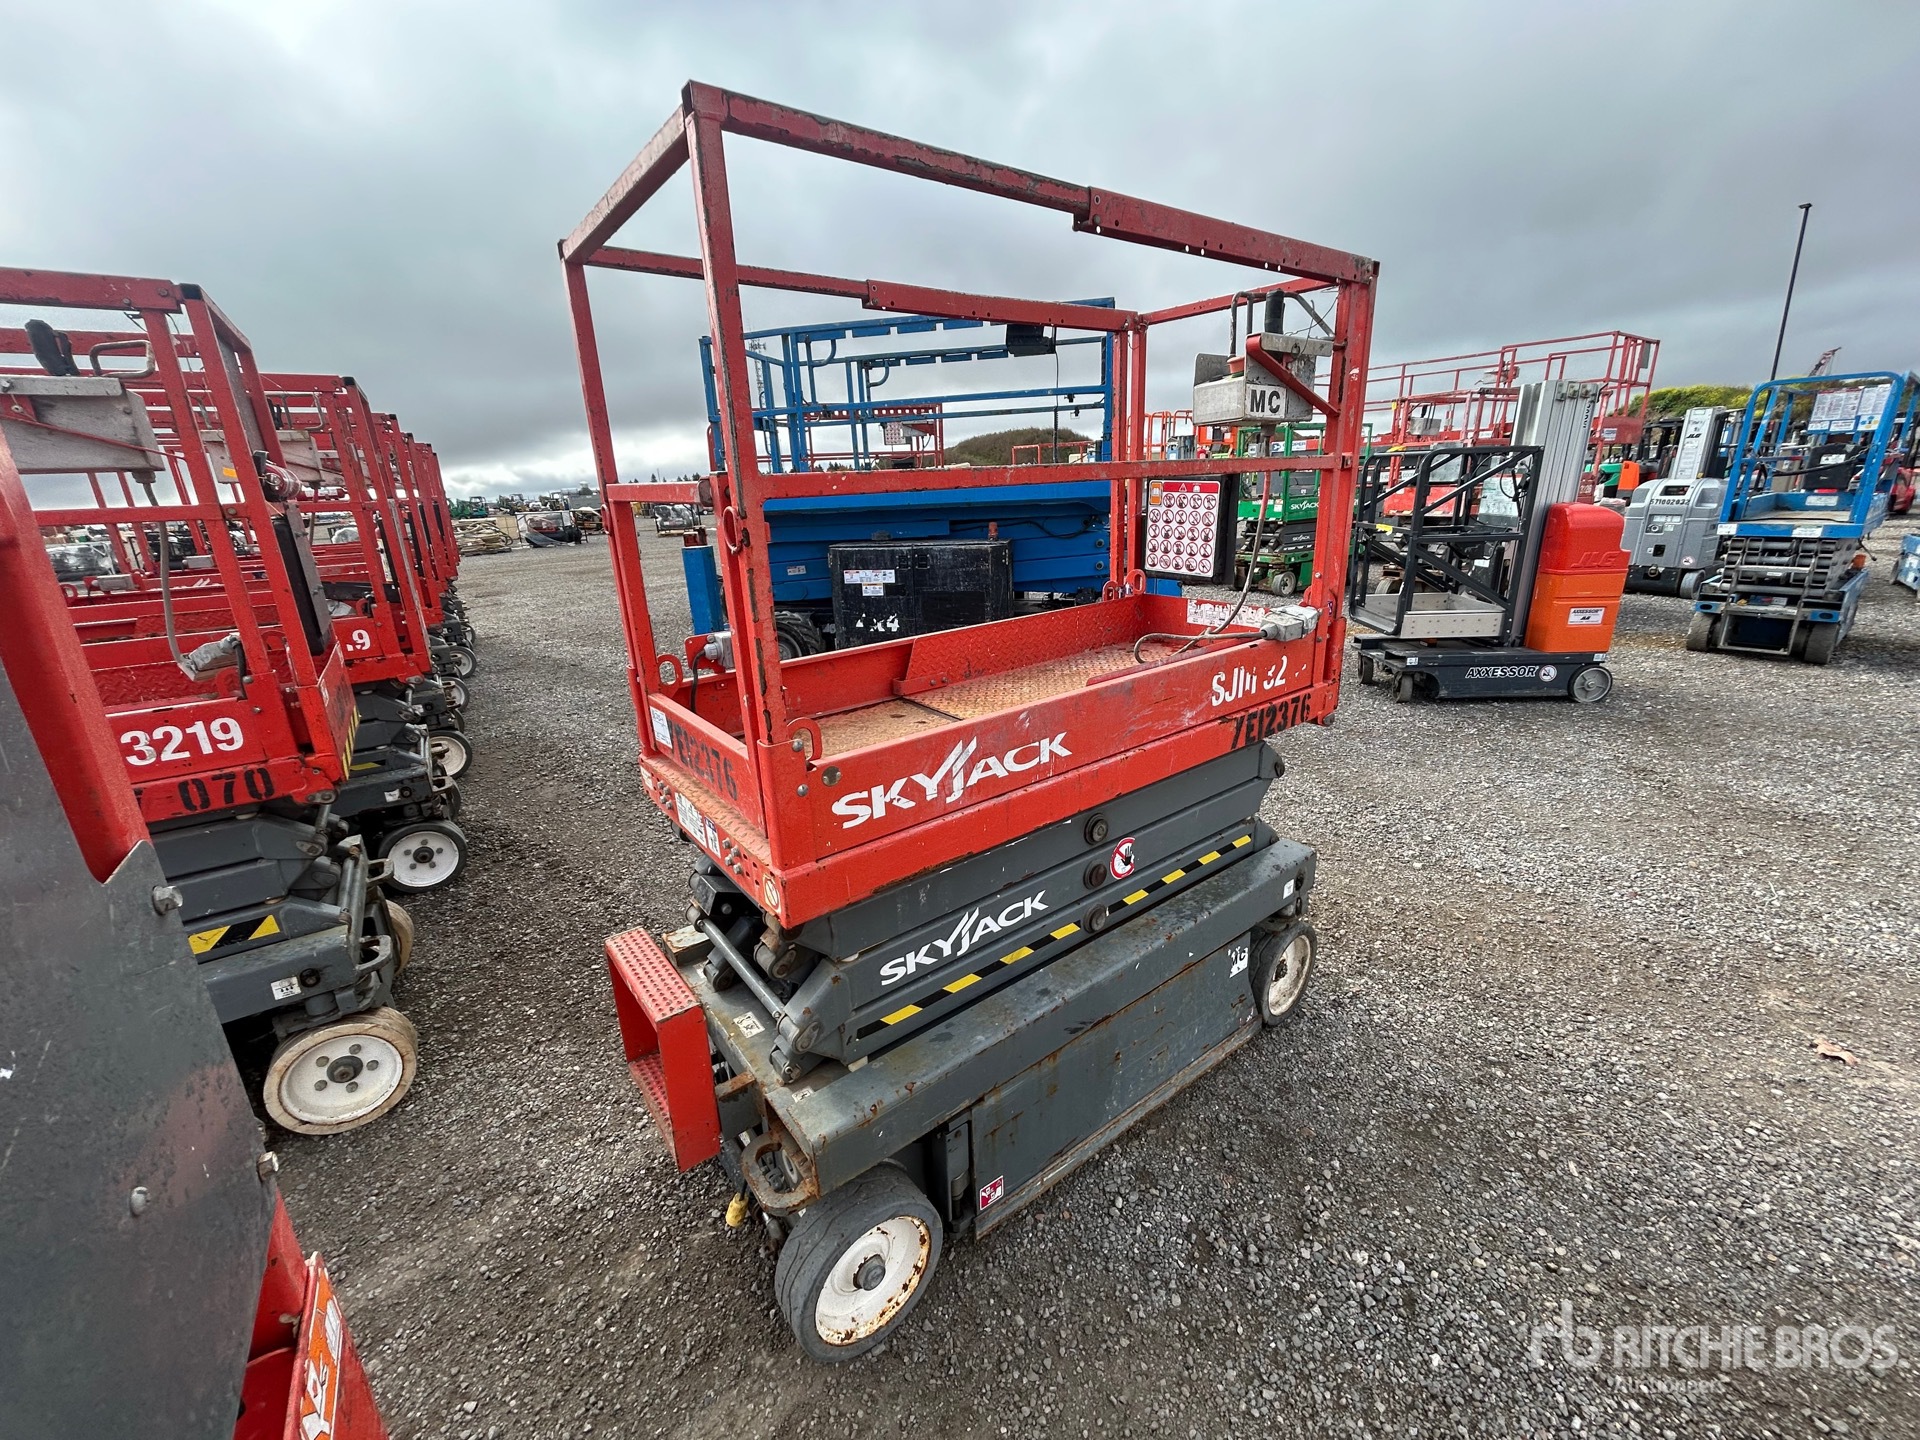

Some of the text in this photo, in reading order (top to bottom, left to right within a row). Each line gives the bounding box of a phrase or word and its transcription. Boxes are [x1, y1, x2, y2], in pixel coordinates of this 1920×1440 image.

[1250, 390, 1281, 413] MC
[1290, 500, 1319, 510] SKYJACK
[1465, 666, 1538, 679] AXXESSOR
[120, 717, 244, 767] 3219
[832, 736, 1073, 829] SKYJACK
[879, 890, 1049, 986] SKYJACK
